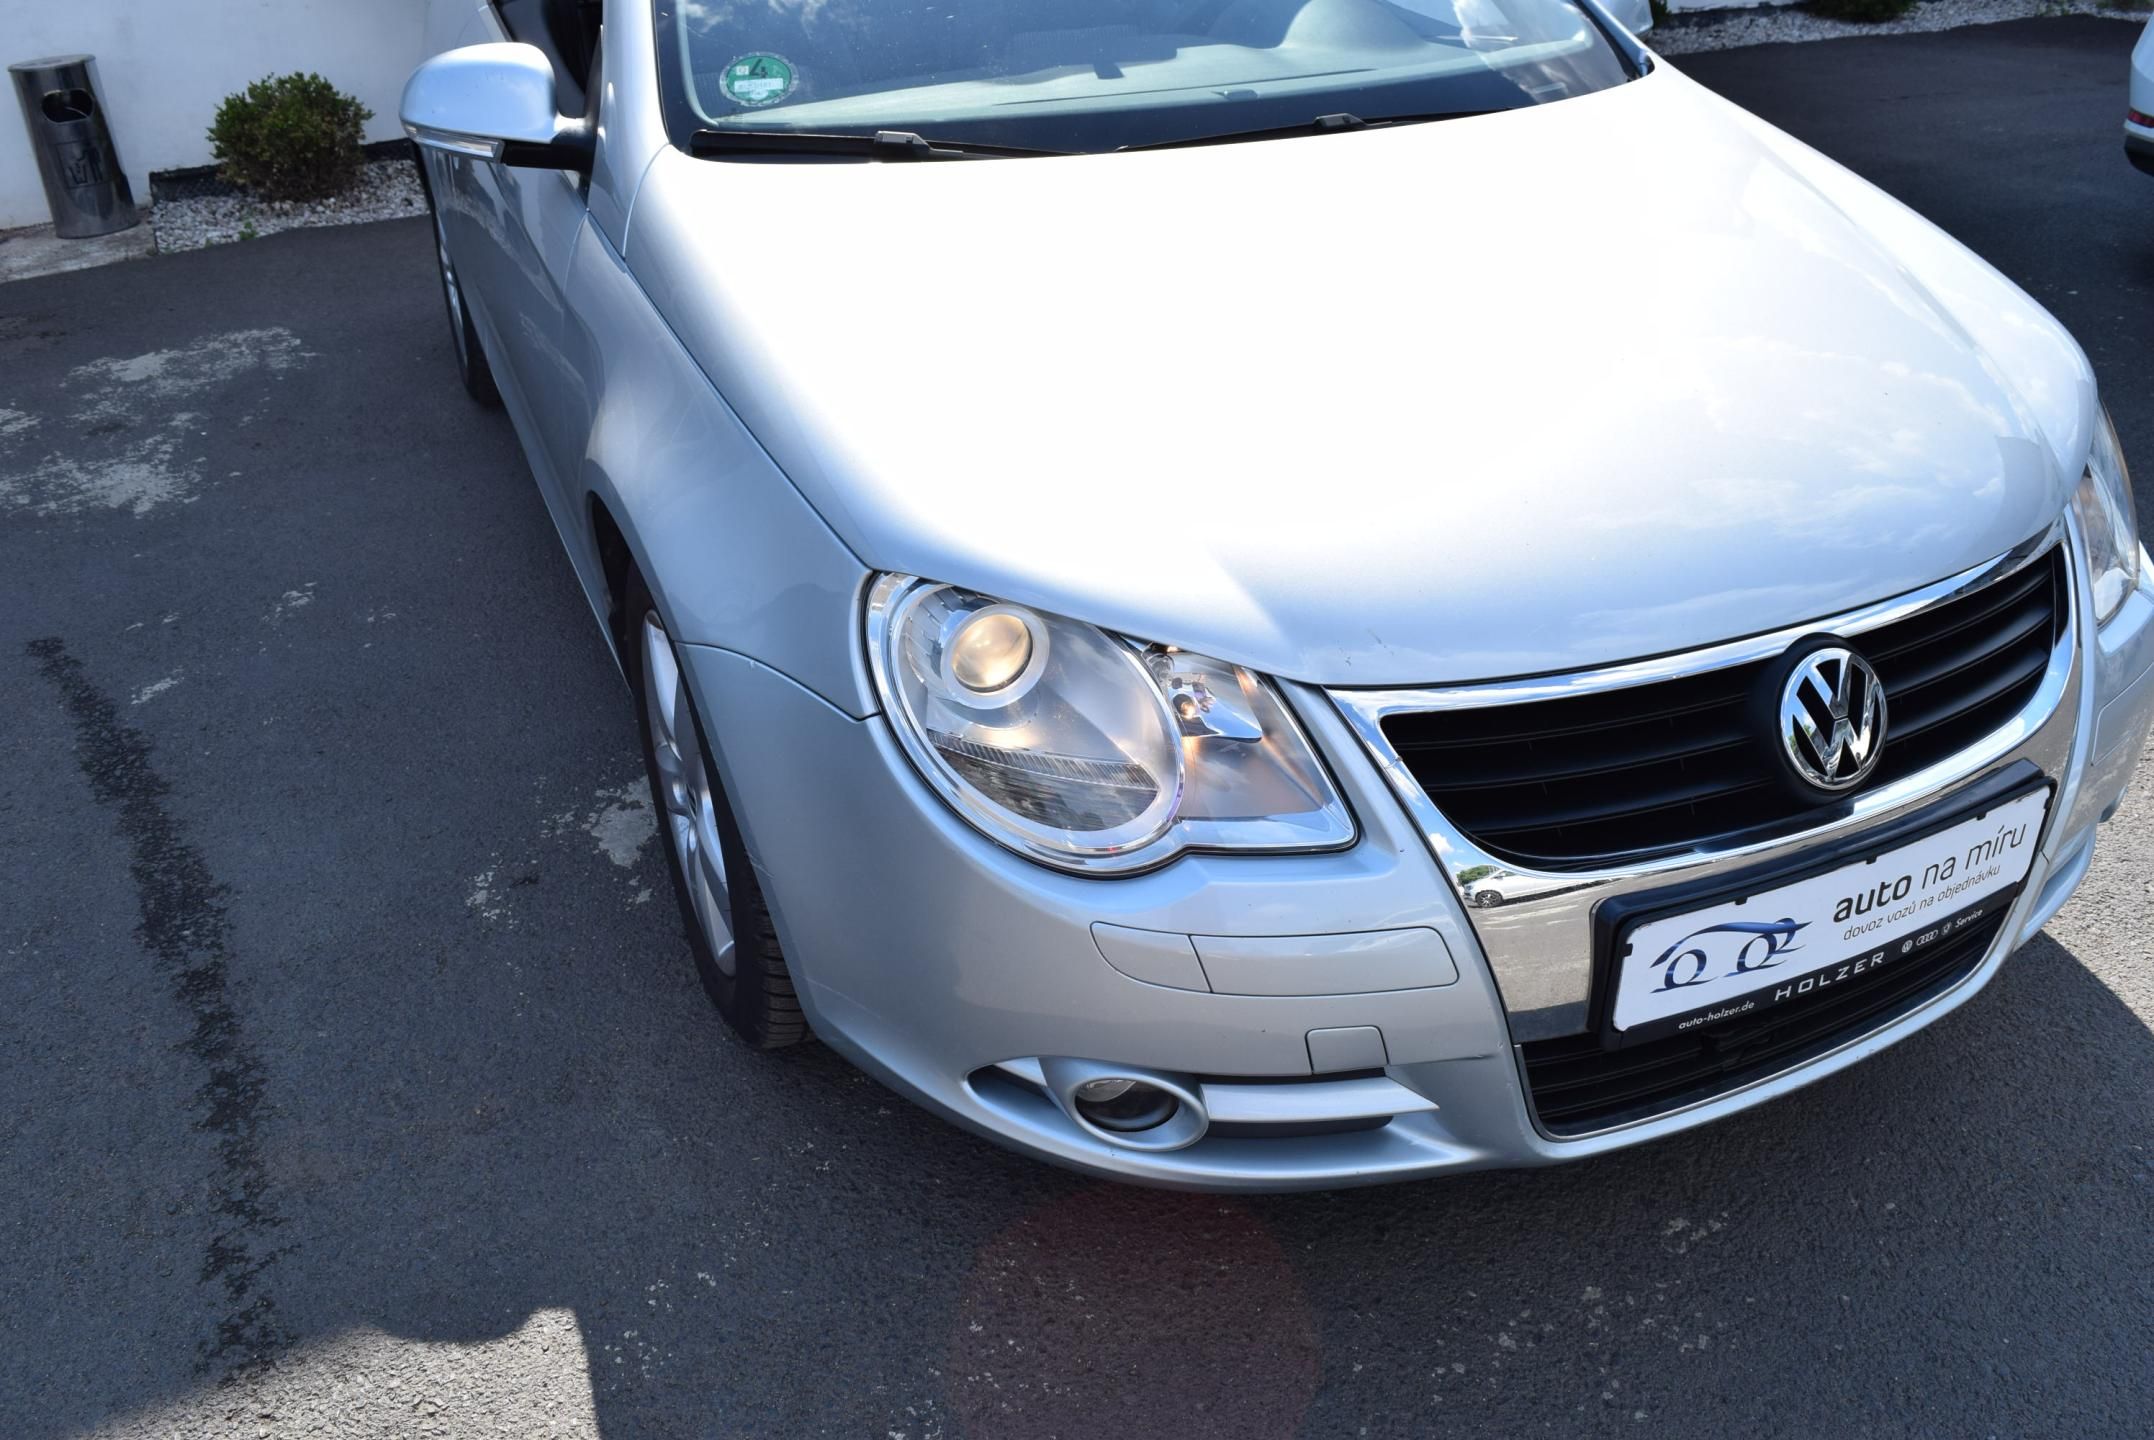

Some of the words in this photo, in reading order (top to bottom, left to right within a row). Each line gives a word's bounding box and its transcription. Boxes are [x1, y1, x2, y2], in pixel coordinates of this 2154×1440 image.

[749, 58, 768, 78] 4
[1833, 874, 1912, 923] auto
[1921, 856, 1956, 889] na
[1965, 823, 2027, 870] míru
[1843, 917, 1883, 941] dovoz
[1887, 900, 1916, 924] vozů
[1919, 895, 1934, 911] na
[1937, 864, 2001, 900] objednávku
[1954, 909, 1983, 928] Service
[1774, 951, 1885, 1001] HOLZER
[1678, 1001, 1755, 1030] auto-holzer.de
